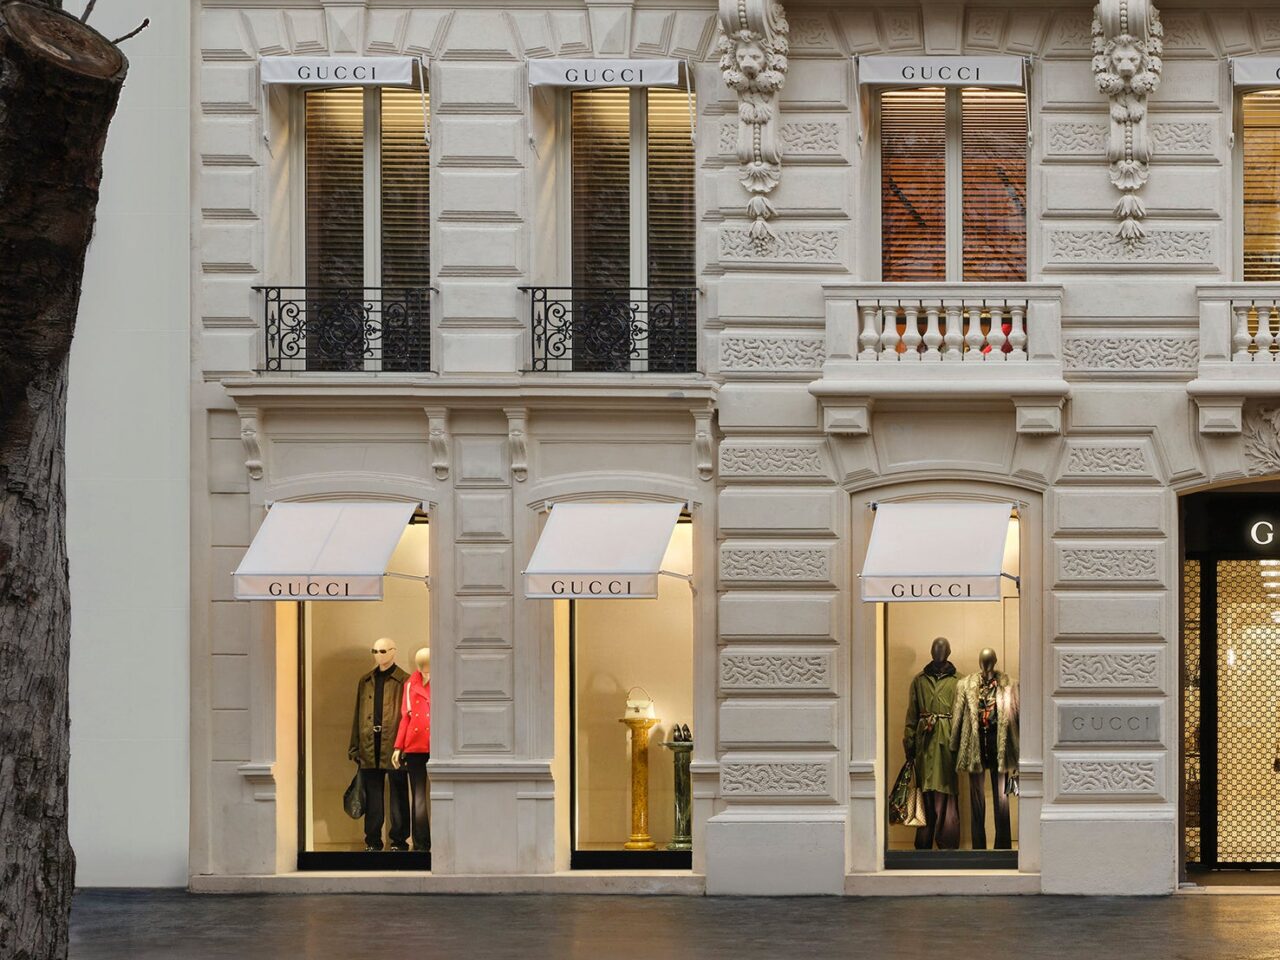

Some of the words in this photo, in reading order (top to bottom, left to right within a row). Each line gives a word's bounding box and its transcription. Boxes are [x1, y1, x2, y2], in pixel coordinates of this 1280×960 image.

[297, 65, 377, 80] GUCCI
[564, 68, 644, 83] GUCCI
[901, 65, 981, 80] GUCCI
[268, 582, 349, 597] GUCCI
[551, 581, 631, 595] GUCCI
[891, 583, 971, 598] GUCCI
[1072, 716, 1149, 731] GUCCI
